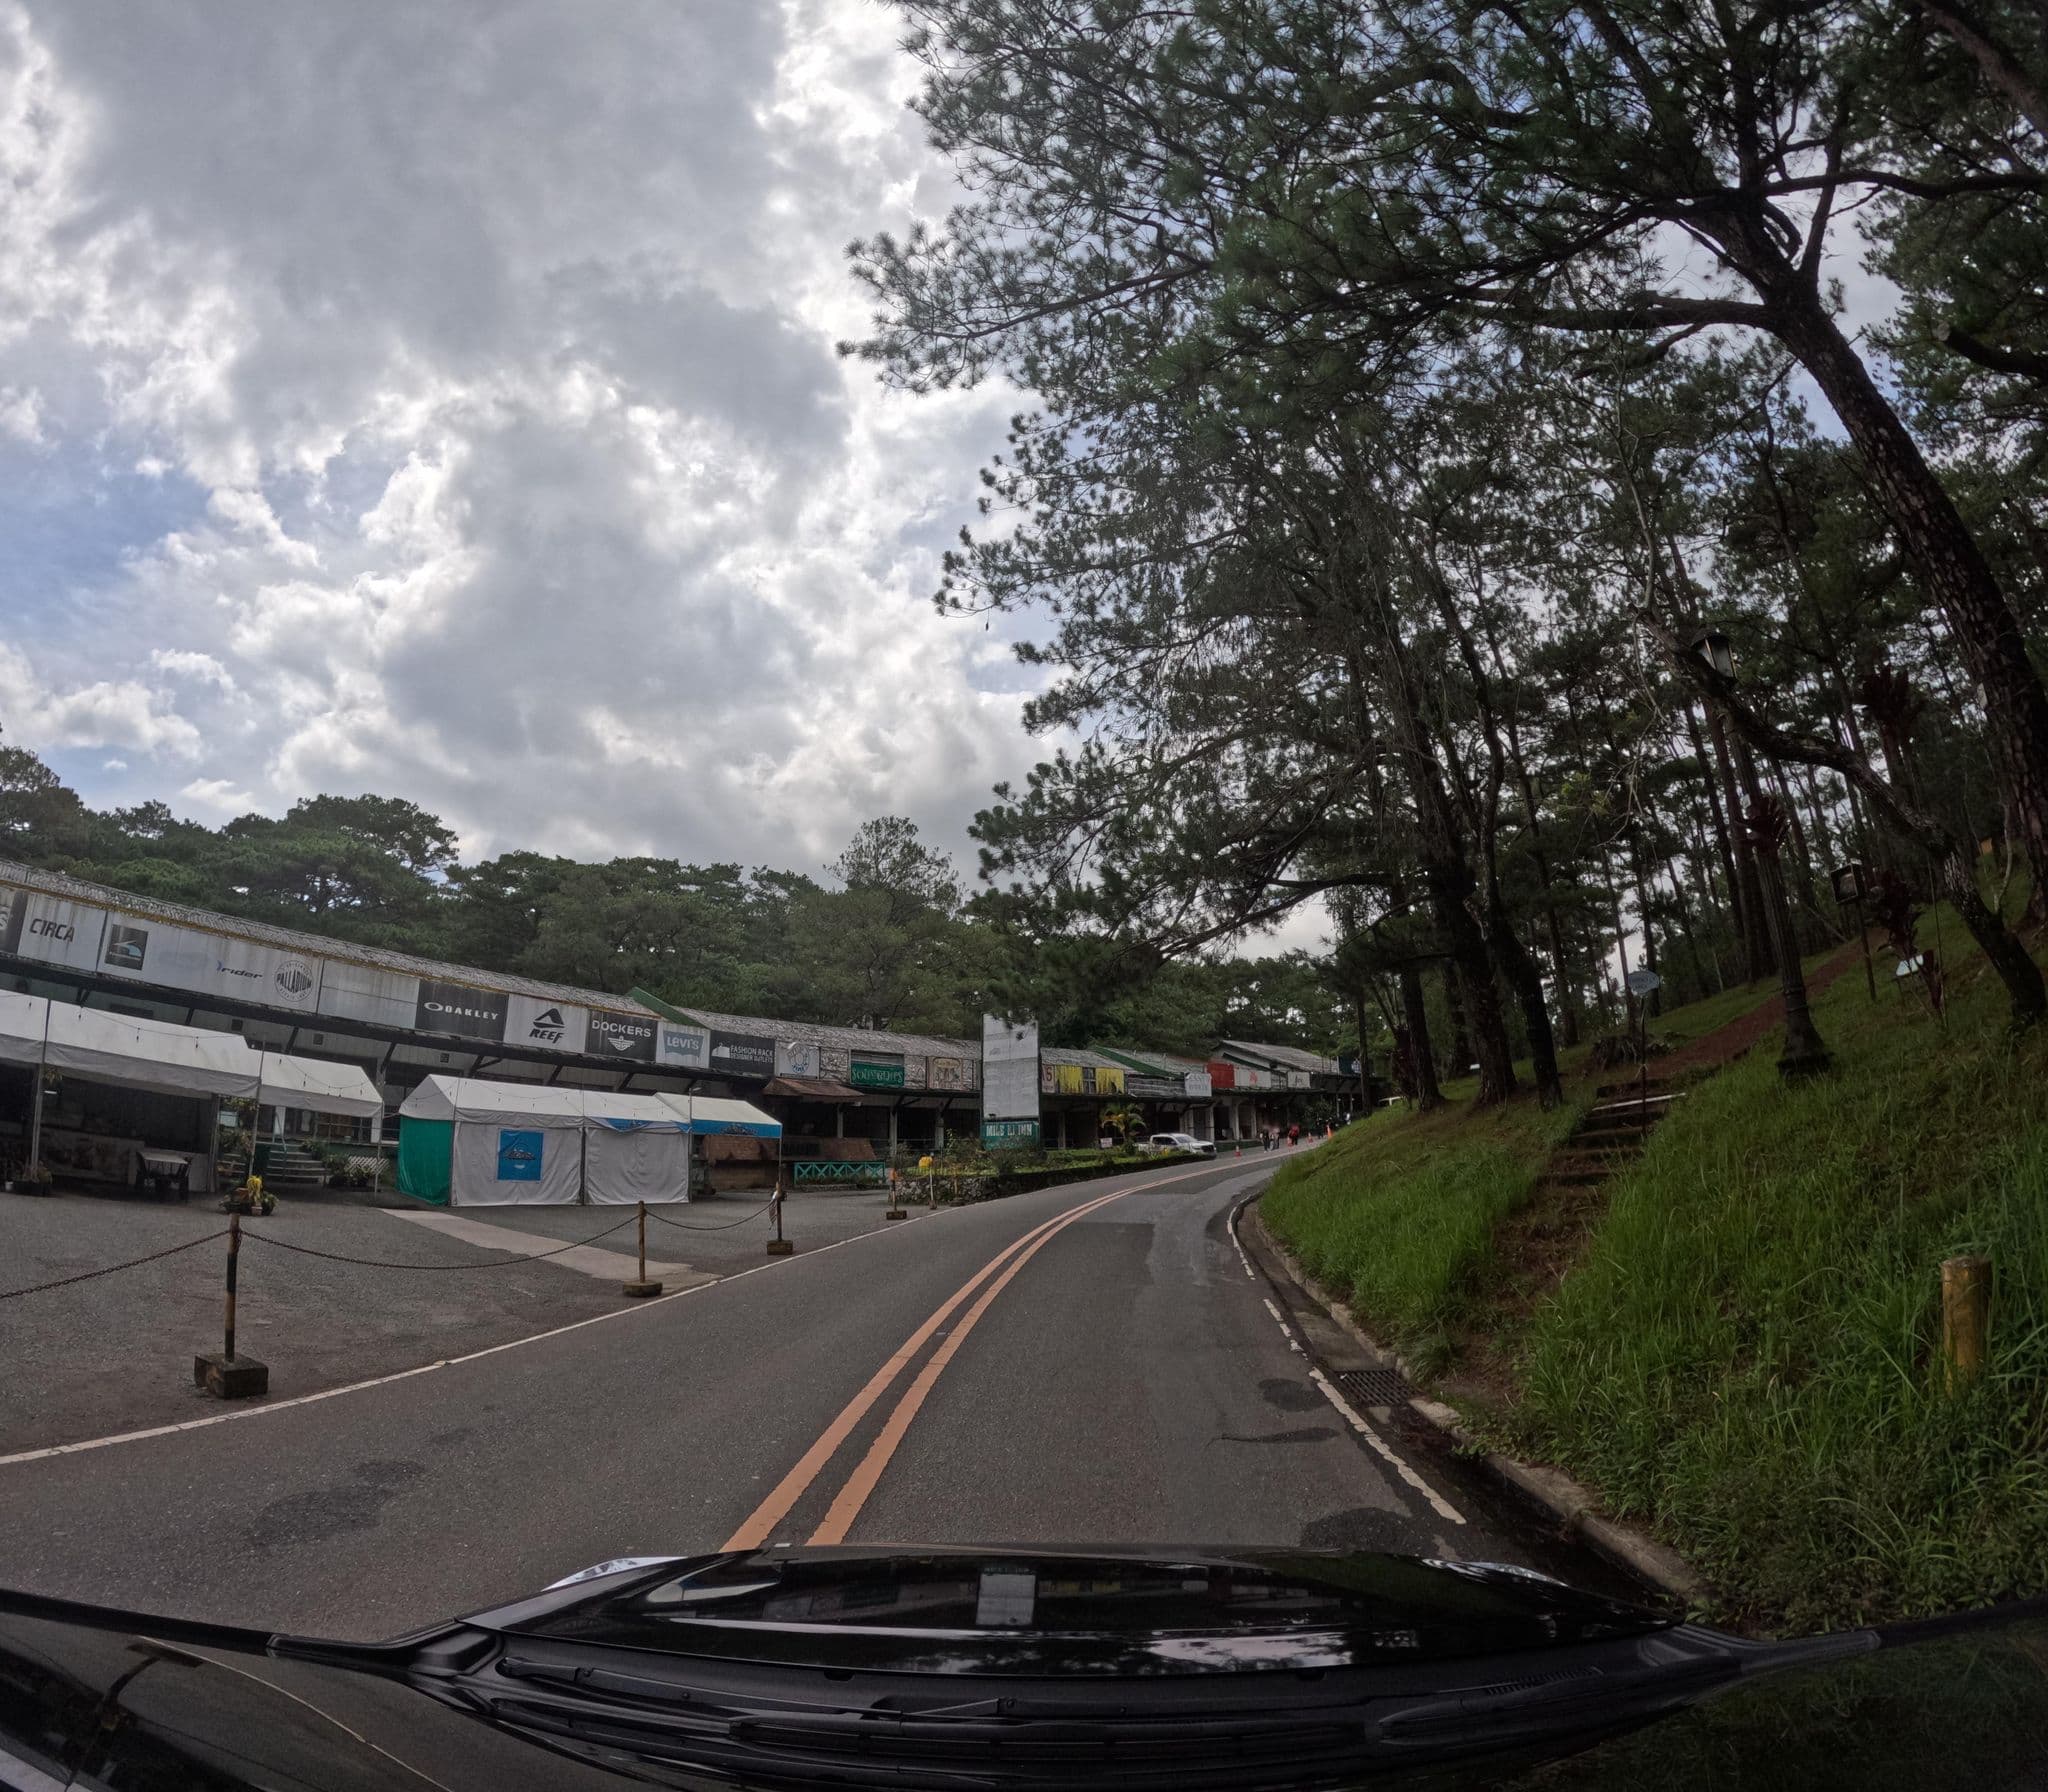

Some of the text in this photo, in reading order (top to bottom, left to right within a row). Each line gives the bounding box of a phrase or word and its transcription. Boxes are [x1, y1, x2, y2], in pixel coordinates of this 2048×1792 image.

[29, 918, 74, 942] CIRCA
[221, 968, 263, 980] rider
[276, 969, 312, 994] PALLADIUM
[444, 1006, 499, 1020] OAKLEY
[529, 1028, 564, 1044] REEF
[592, 1019, 652, 1038] DOCKERS
[730, 1045, 774, 1057] FASHION RACK
